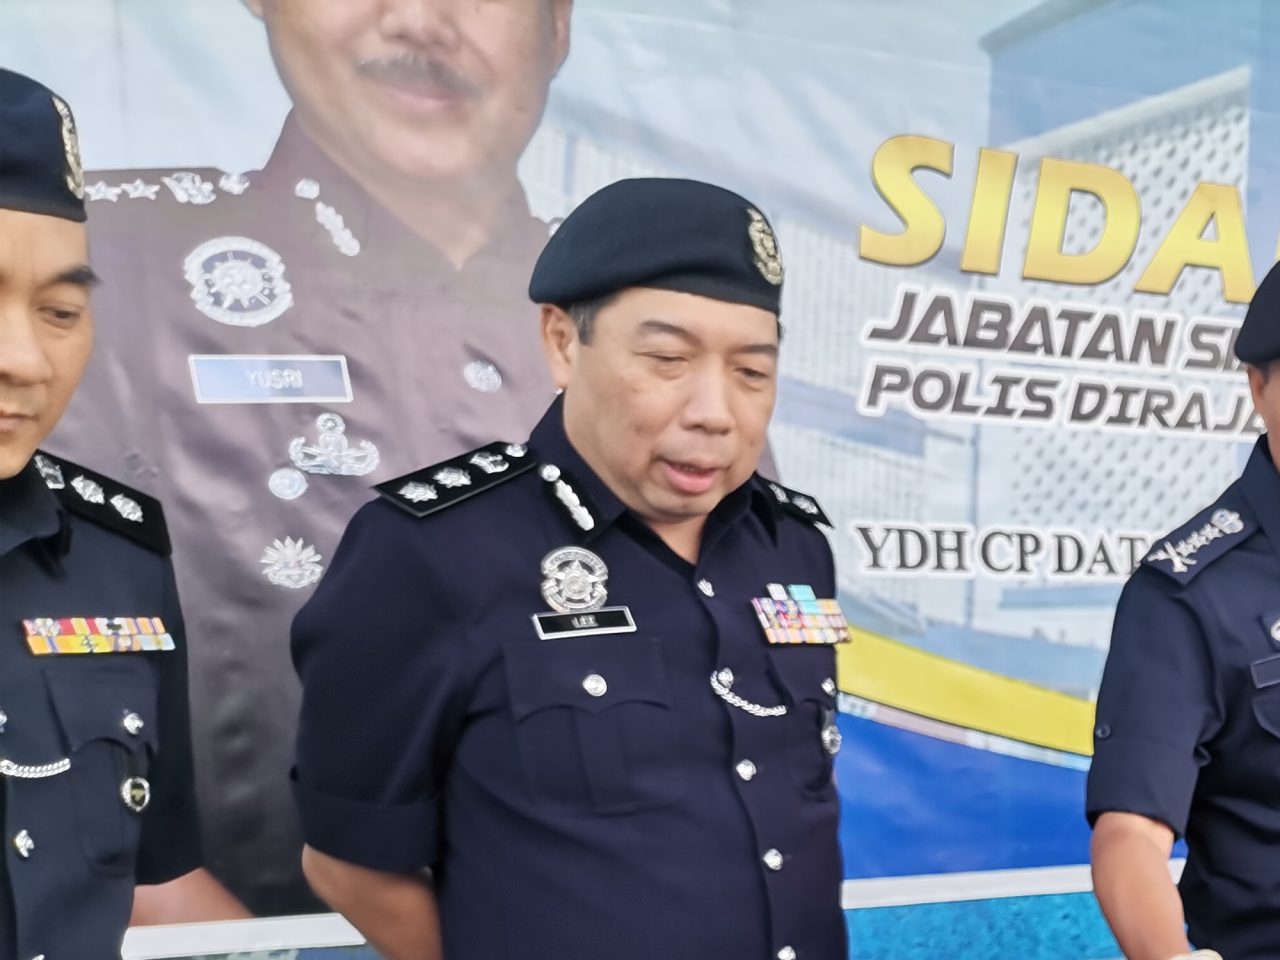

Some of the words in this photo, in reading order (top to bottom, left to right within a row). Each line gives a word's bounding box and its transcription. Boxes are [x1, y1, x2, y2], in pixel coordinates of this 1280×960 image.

[868, 291, 1177, 367] JABATAN
[247, 368, 303, 390] YUSRI
[868, 364, 1061, 420] POLIS
[855, 526, 970, 572] YDH
[980, 530, 1042, 574] CP
